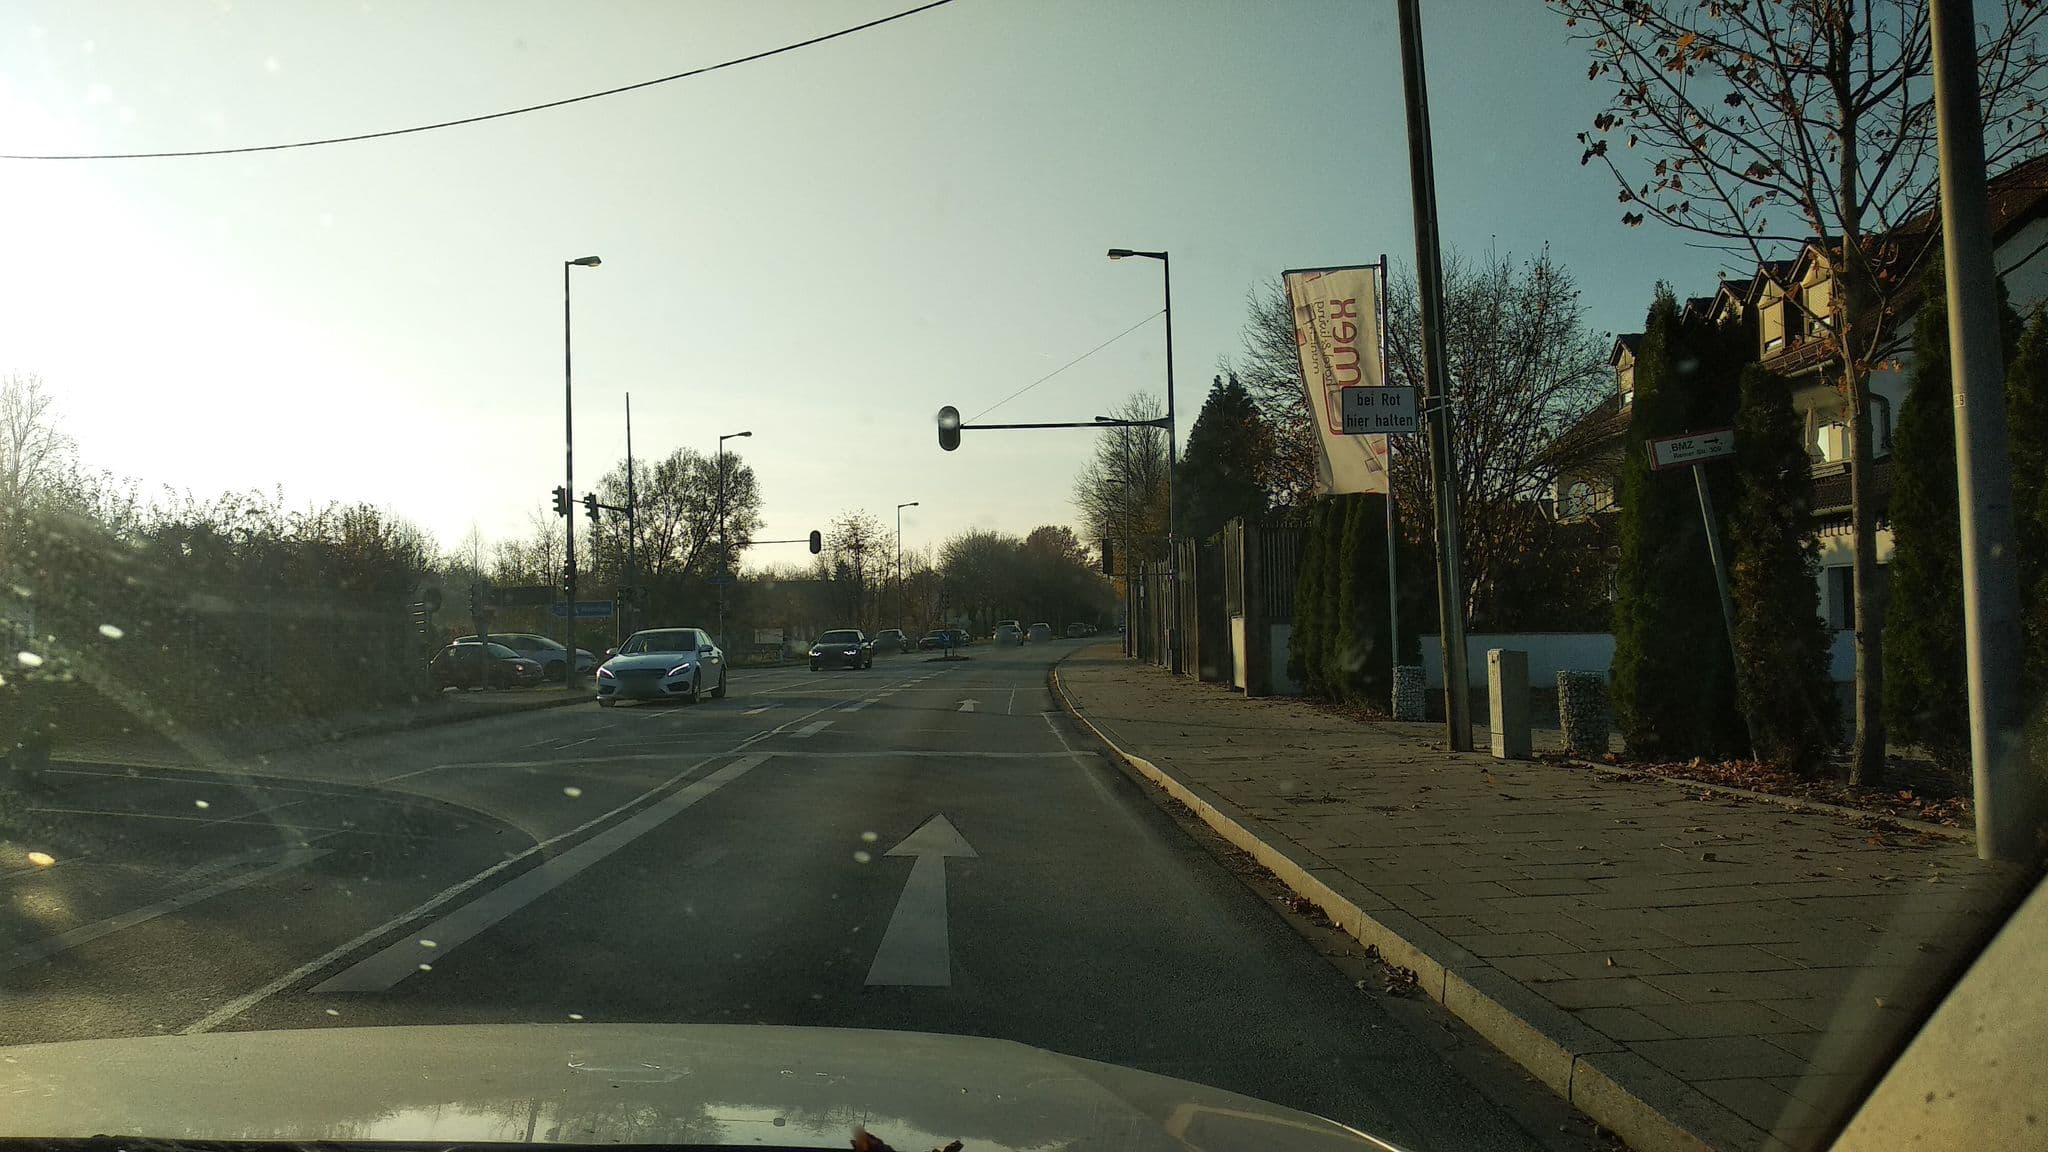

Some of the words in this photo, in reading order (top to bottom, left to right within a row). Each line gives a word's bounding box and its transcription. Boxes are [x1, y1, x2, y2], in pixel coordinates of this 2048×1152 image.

[1357, 392, 1374, 406] bei
[1382, 393, 1400, 406] Rot
[1346, 414, 1369, 427] hier
[1375, 414, 1413, 427] halten
[1671, 440, 1694, 451] BMZ
